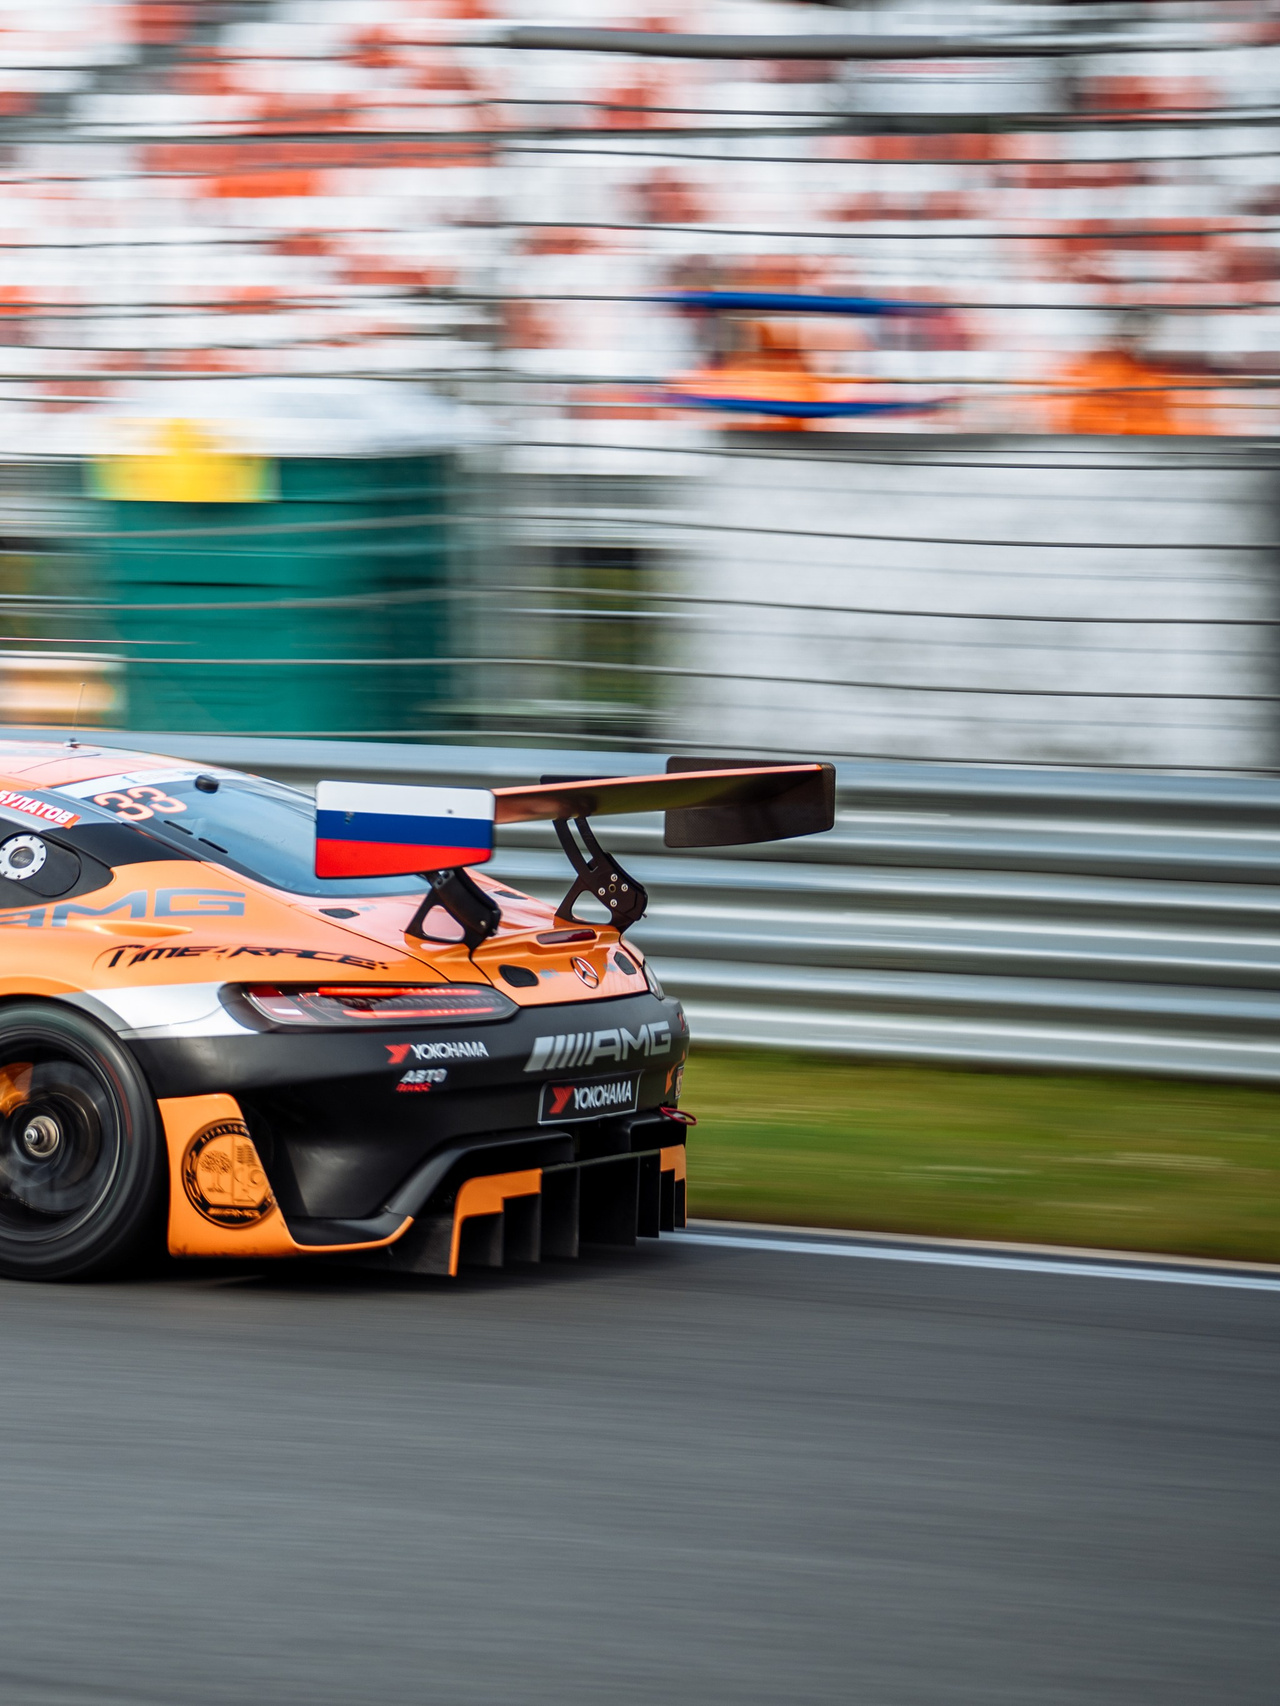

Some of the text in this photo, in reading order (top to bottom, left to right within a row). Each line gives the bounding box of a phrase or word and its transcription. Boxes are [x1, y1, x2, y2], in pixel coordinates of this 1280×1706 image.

[93, 786, 188, 821] 33
[410, 1041, 490, 1060] YOKOHAMA
[573, 1080, 632, 1110] YOKOHAMA
